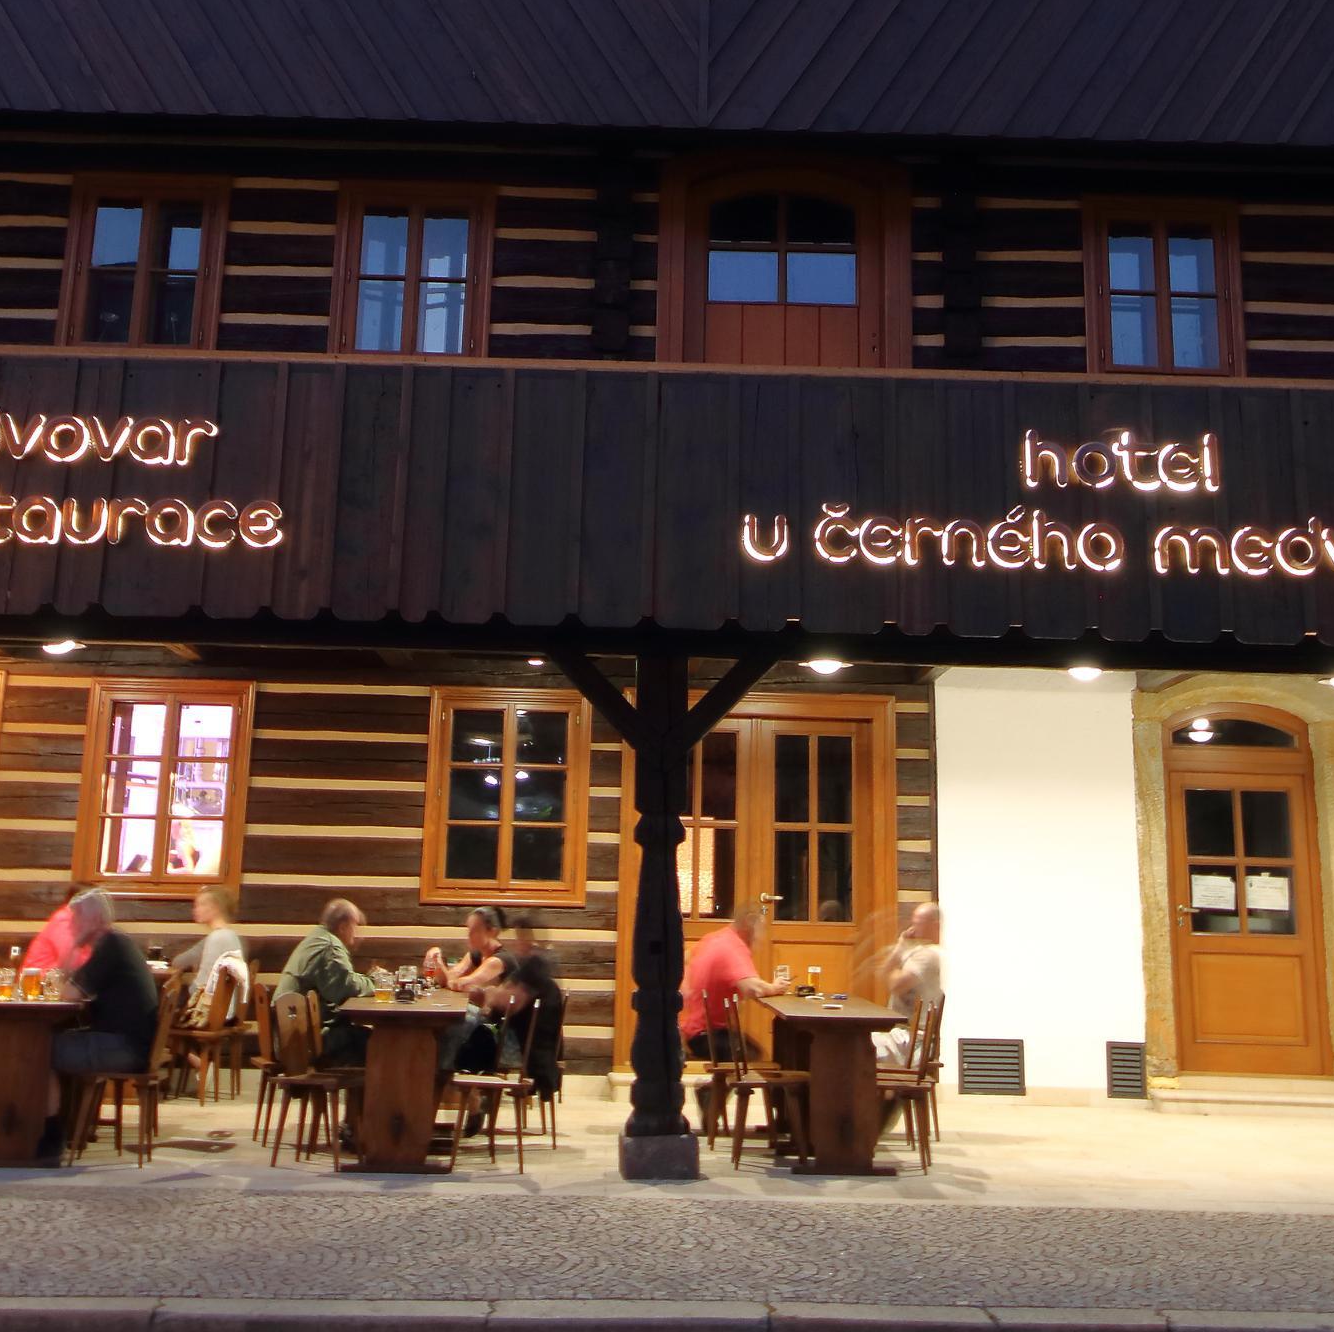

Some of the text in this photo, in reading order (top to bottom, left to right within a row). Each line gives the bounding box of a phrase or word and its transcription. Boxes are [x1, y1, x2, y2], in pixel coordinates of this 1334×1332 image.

[1020, 428, 1222, 493] hotel
[741, 512, 790, 563] u
[814, 503, 1125, 573] černého
